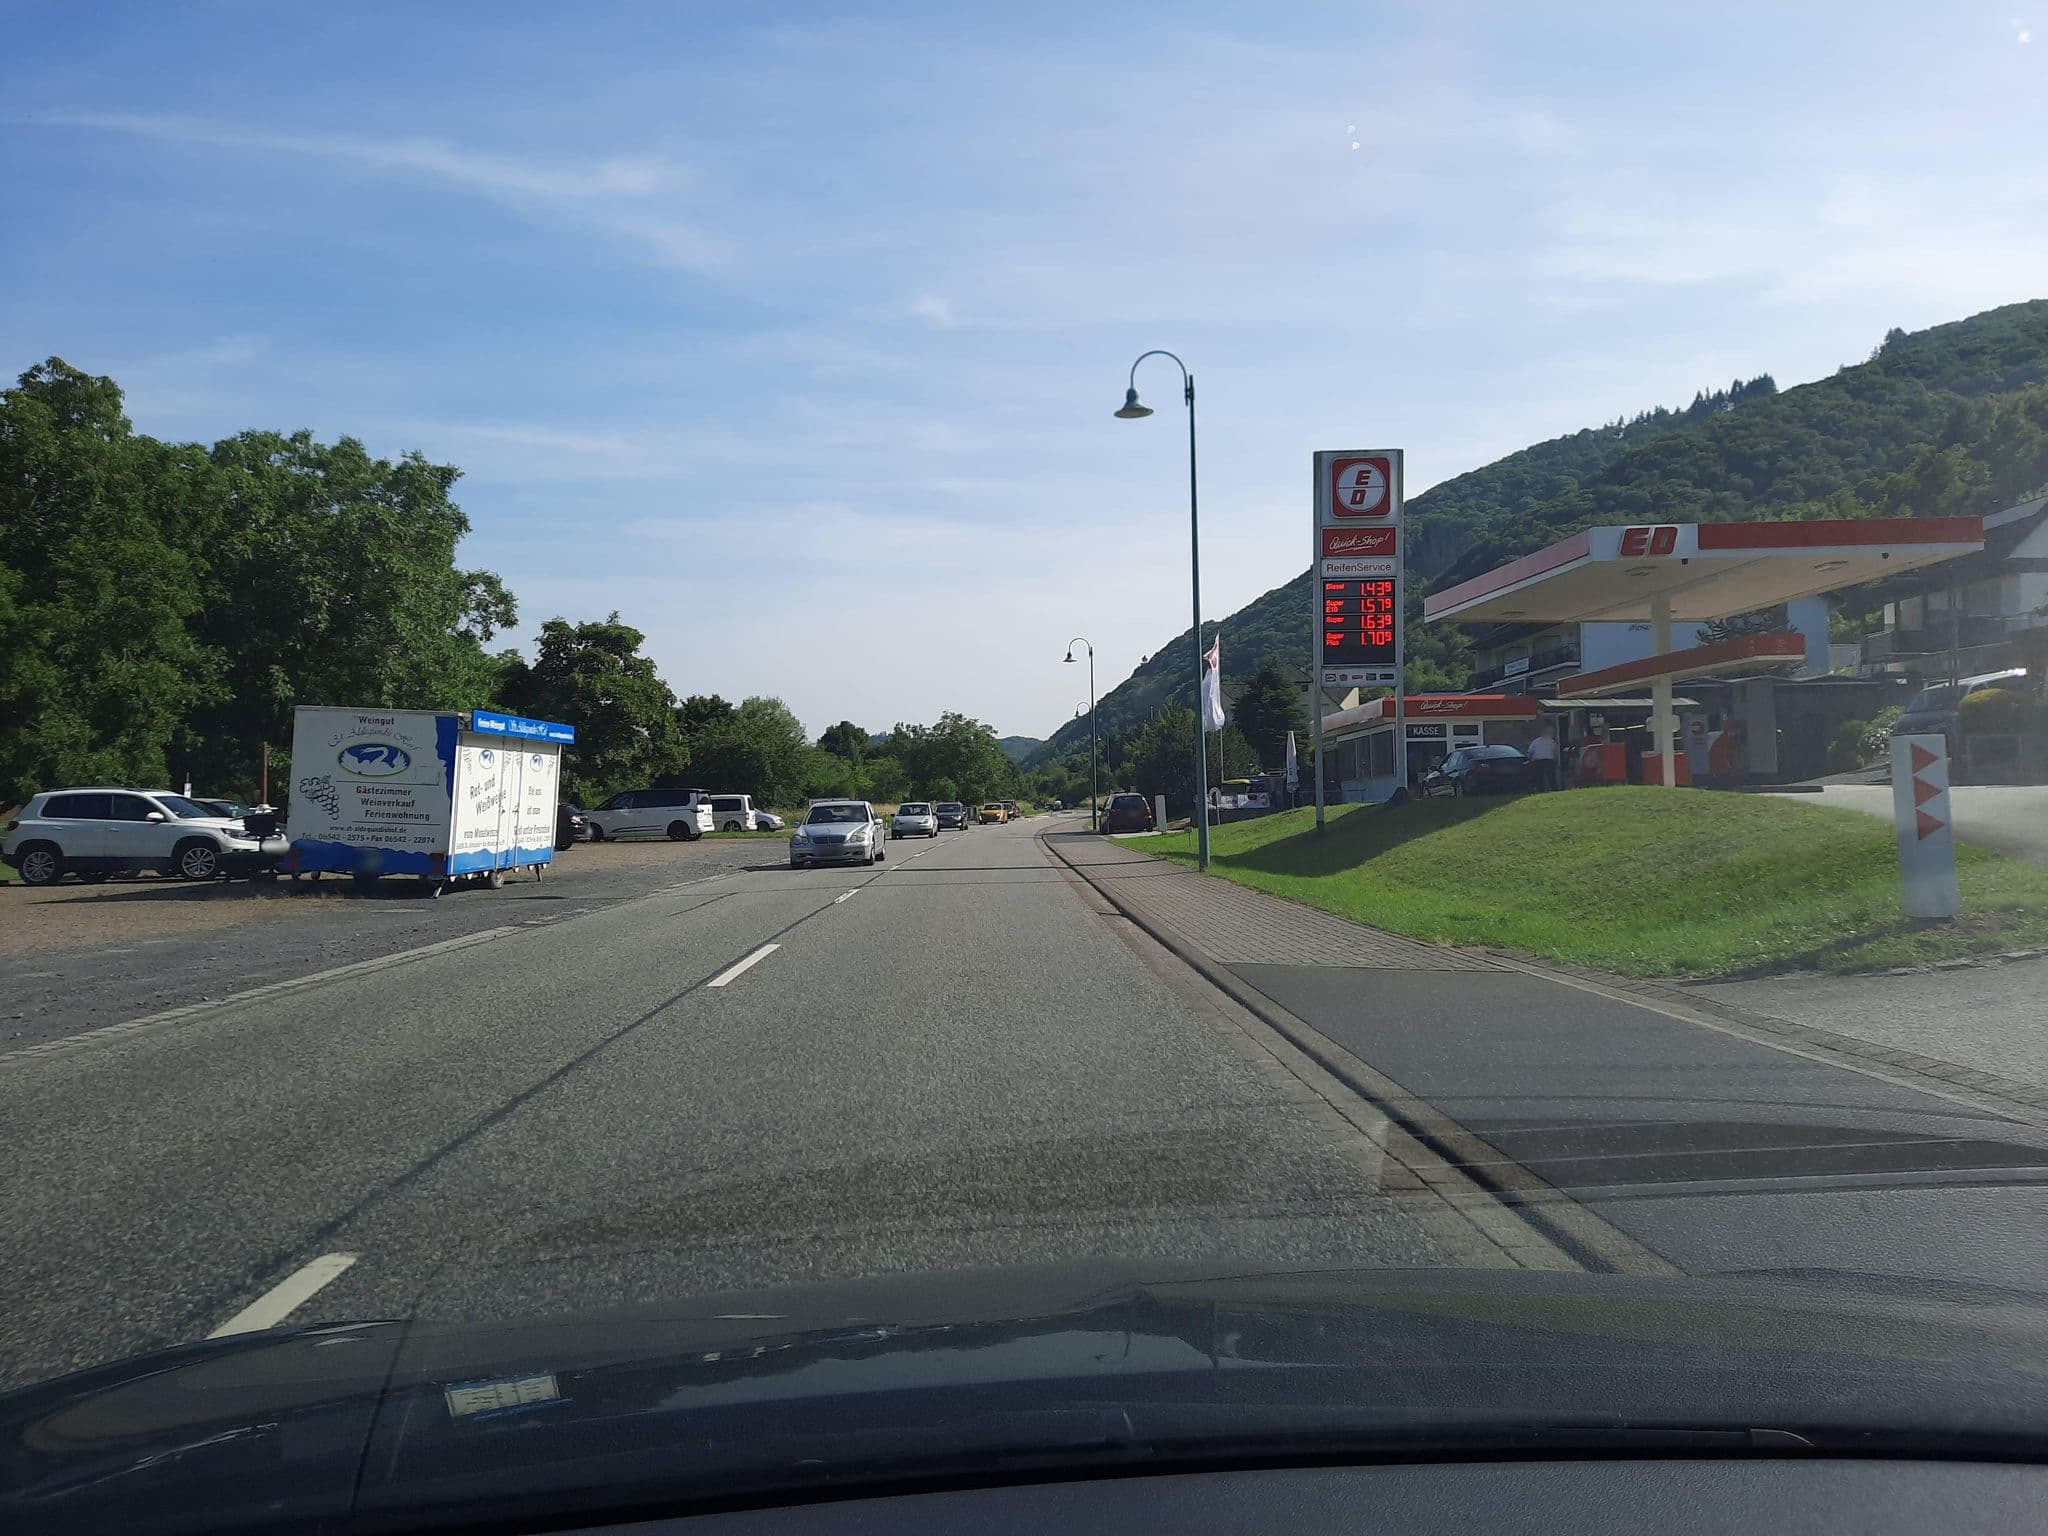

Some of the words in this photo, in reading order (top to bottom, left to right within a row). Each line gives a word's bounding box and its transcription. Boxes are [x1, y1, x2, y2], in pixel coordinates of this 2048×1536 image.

[1329, 532, 1391, 552] Quick-Shop!
[1620, 527, 1678, 556] ED
[1326, 562, 1392, 573] ReifenService
[1326, 616, 1344, 624] Super
[1326, 633, 1344, 641] Super
[1420, 700, 1469, 713] Quick-Shop!
[359, 716, 395, 726] Weingut
[1413, 727, 1440, 736] KASSE
[356, 786, 412, 796] Gästezimmer
[361, 798, 416, 808] Weinverkauf
[365, 810, 430, 821] Ferienwohnung
